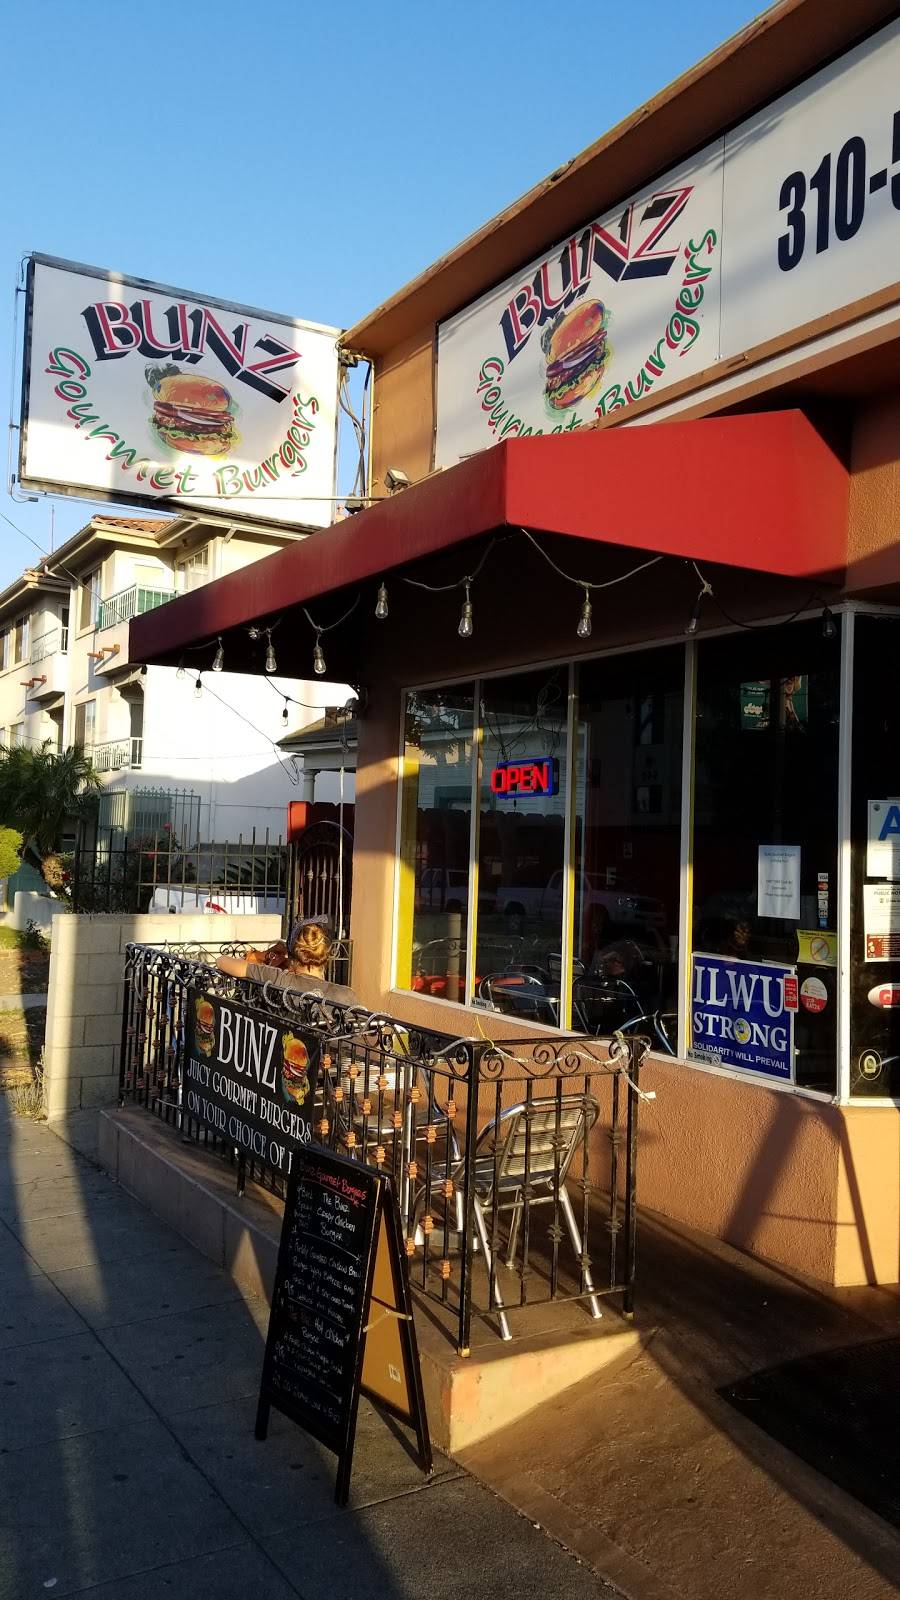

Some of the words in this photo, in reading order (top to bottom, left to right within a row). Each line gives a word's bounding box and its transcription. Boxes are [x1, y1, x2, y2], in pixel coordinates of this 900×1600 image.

[778, 110, 900, 272] 310-
[499, 186, 695, 364] BUNZ
[80, 299, 302, 404] BUNZ
[595, 228, 717, 418] Burgers
[45, 347, 199, 494] Gourmet
[212, 393, 320, 499] Burgers
[491, 766, 549, 794] OPEN
[878, 804, 900, 841] A
[693, 965, 785, 1018] ILWU
[693, 1011, 788, 1052] STRONG
[217, 1006, 279, 1093] BUNZ
[693, 1041, 734, 1056] SOLIDARITY
[735, 1051, 755, 1063] WILL
[755, 1055, 789, 1071] PREVAIL
[187, 1058, 212, 1087] JUICY
[212, 1071, 257, 1115] GOURMET
[260, 1097, 312, 1147] BURGERS
[187, 1090, 200, 1113] ON
[202, 1098, 226, 1133] YOUR
[228, 1115, 266, 1159] CHOICE
[269, 1141, 286, 1170] OF
